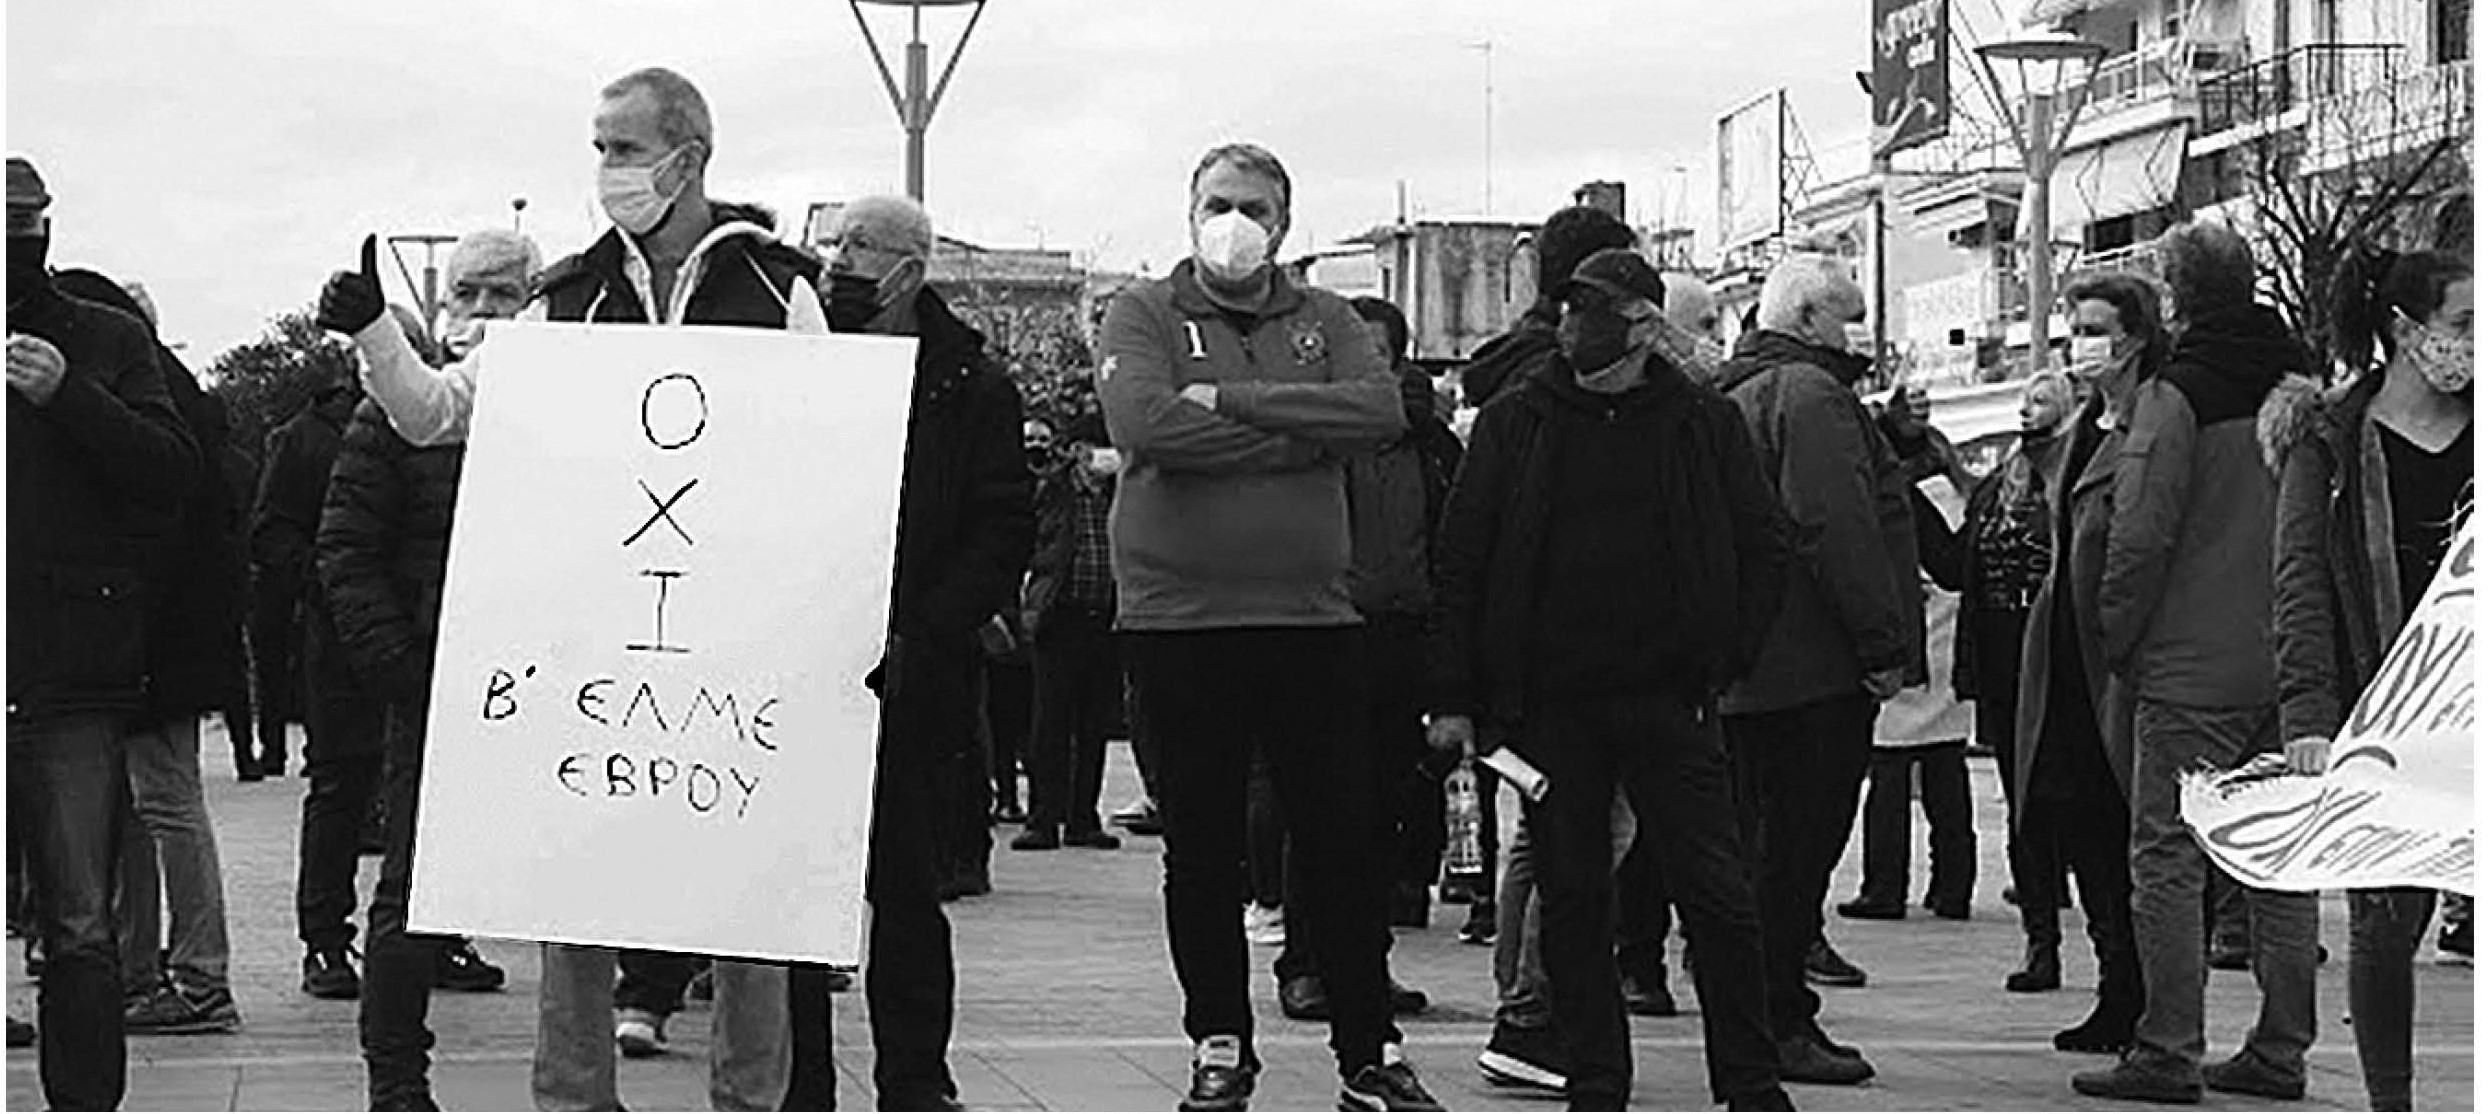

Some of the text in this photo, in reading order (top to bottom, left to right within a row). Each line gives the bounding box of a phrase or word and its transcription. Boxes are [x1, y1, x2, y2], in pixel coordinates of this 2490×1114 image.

[1183, 320, 1208, 359] 1
[576, 679, 779, 751] ΕΛΜΕ
[557, 752, 760, 818] ΕΒΡΟΥ
